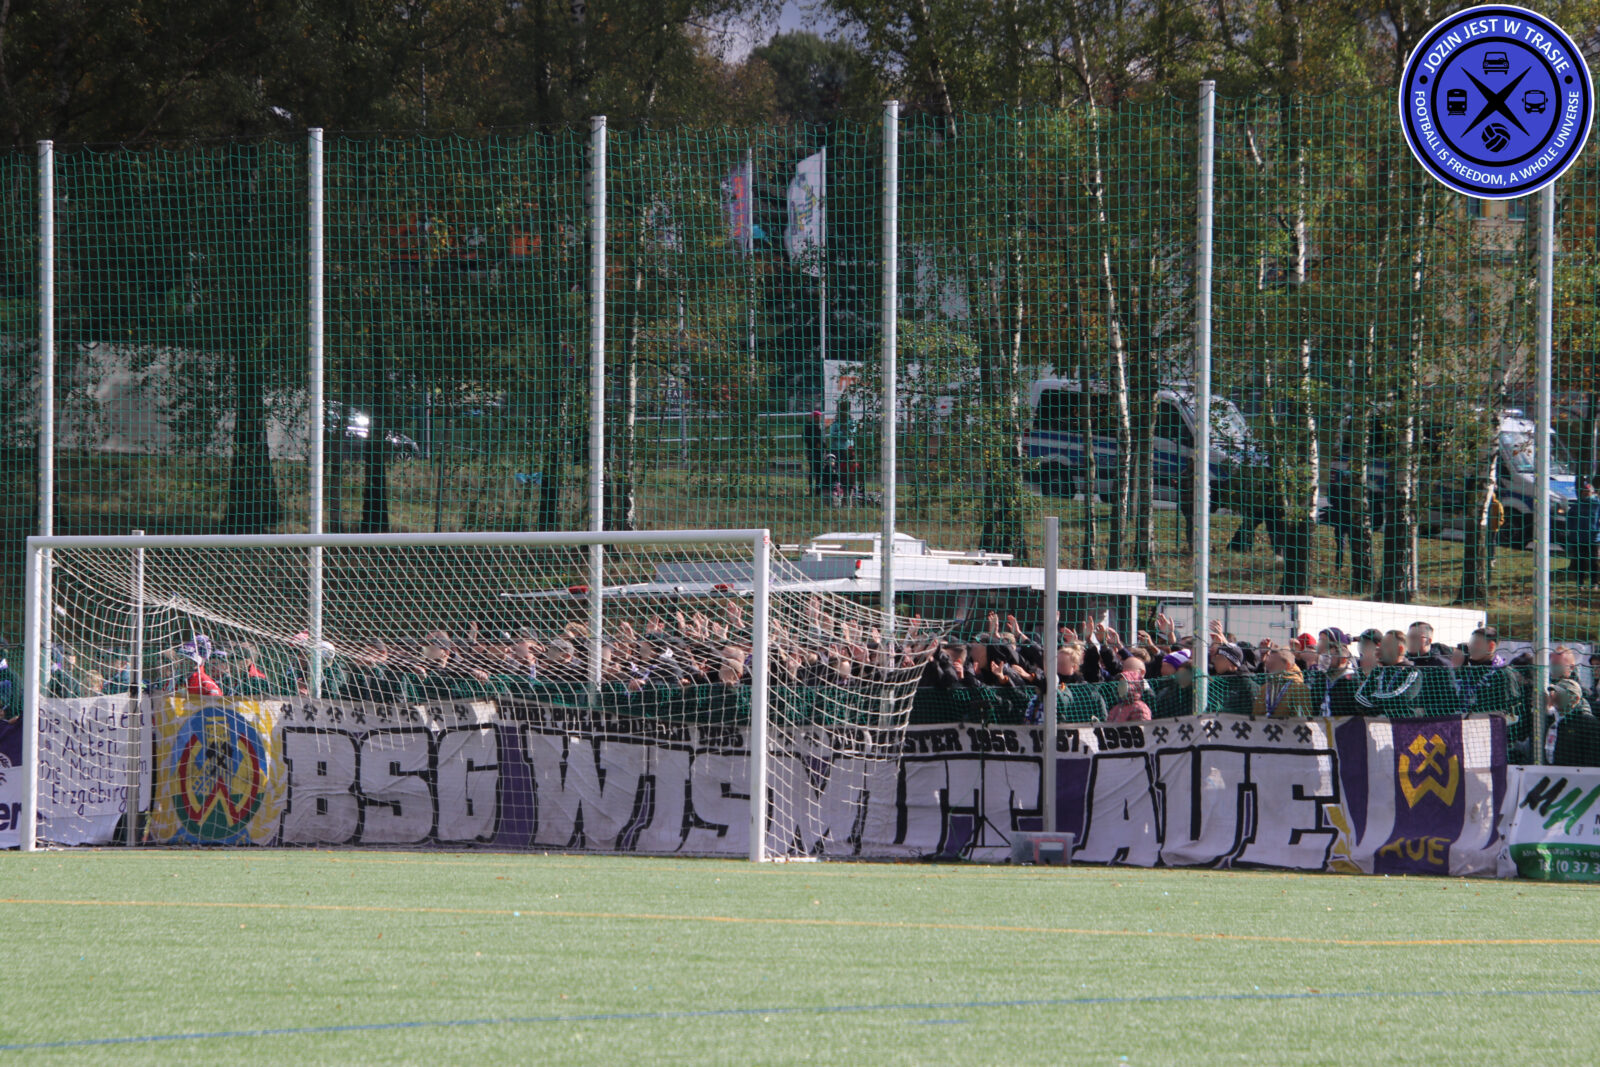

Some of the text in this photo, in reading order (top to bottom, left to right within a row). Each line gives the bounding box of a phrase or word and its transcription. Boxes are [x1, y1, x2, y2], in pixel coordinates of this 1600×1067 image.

[38, 708, 60, 733] Die
[966, 727, 1025, 754] 1956,
[1094, 725, 1145, 751] 1959
[40, 759, 61, 780] Die
[52, 781, 131, 816] Erzgebirg
[281, 723, 499, 847] BSG
[1073, 744, 1340, 870] AUE
[1379, 835, 1451, 865] AUE
[1556, 859, 1569, 874] (0
[1572, 861, 1589, 873] 37
